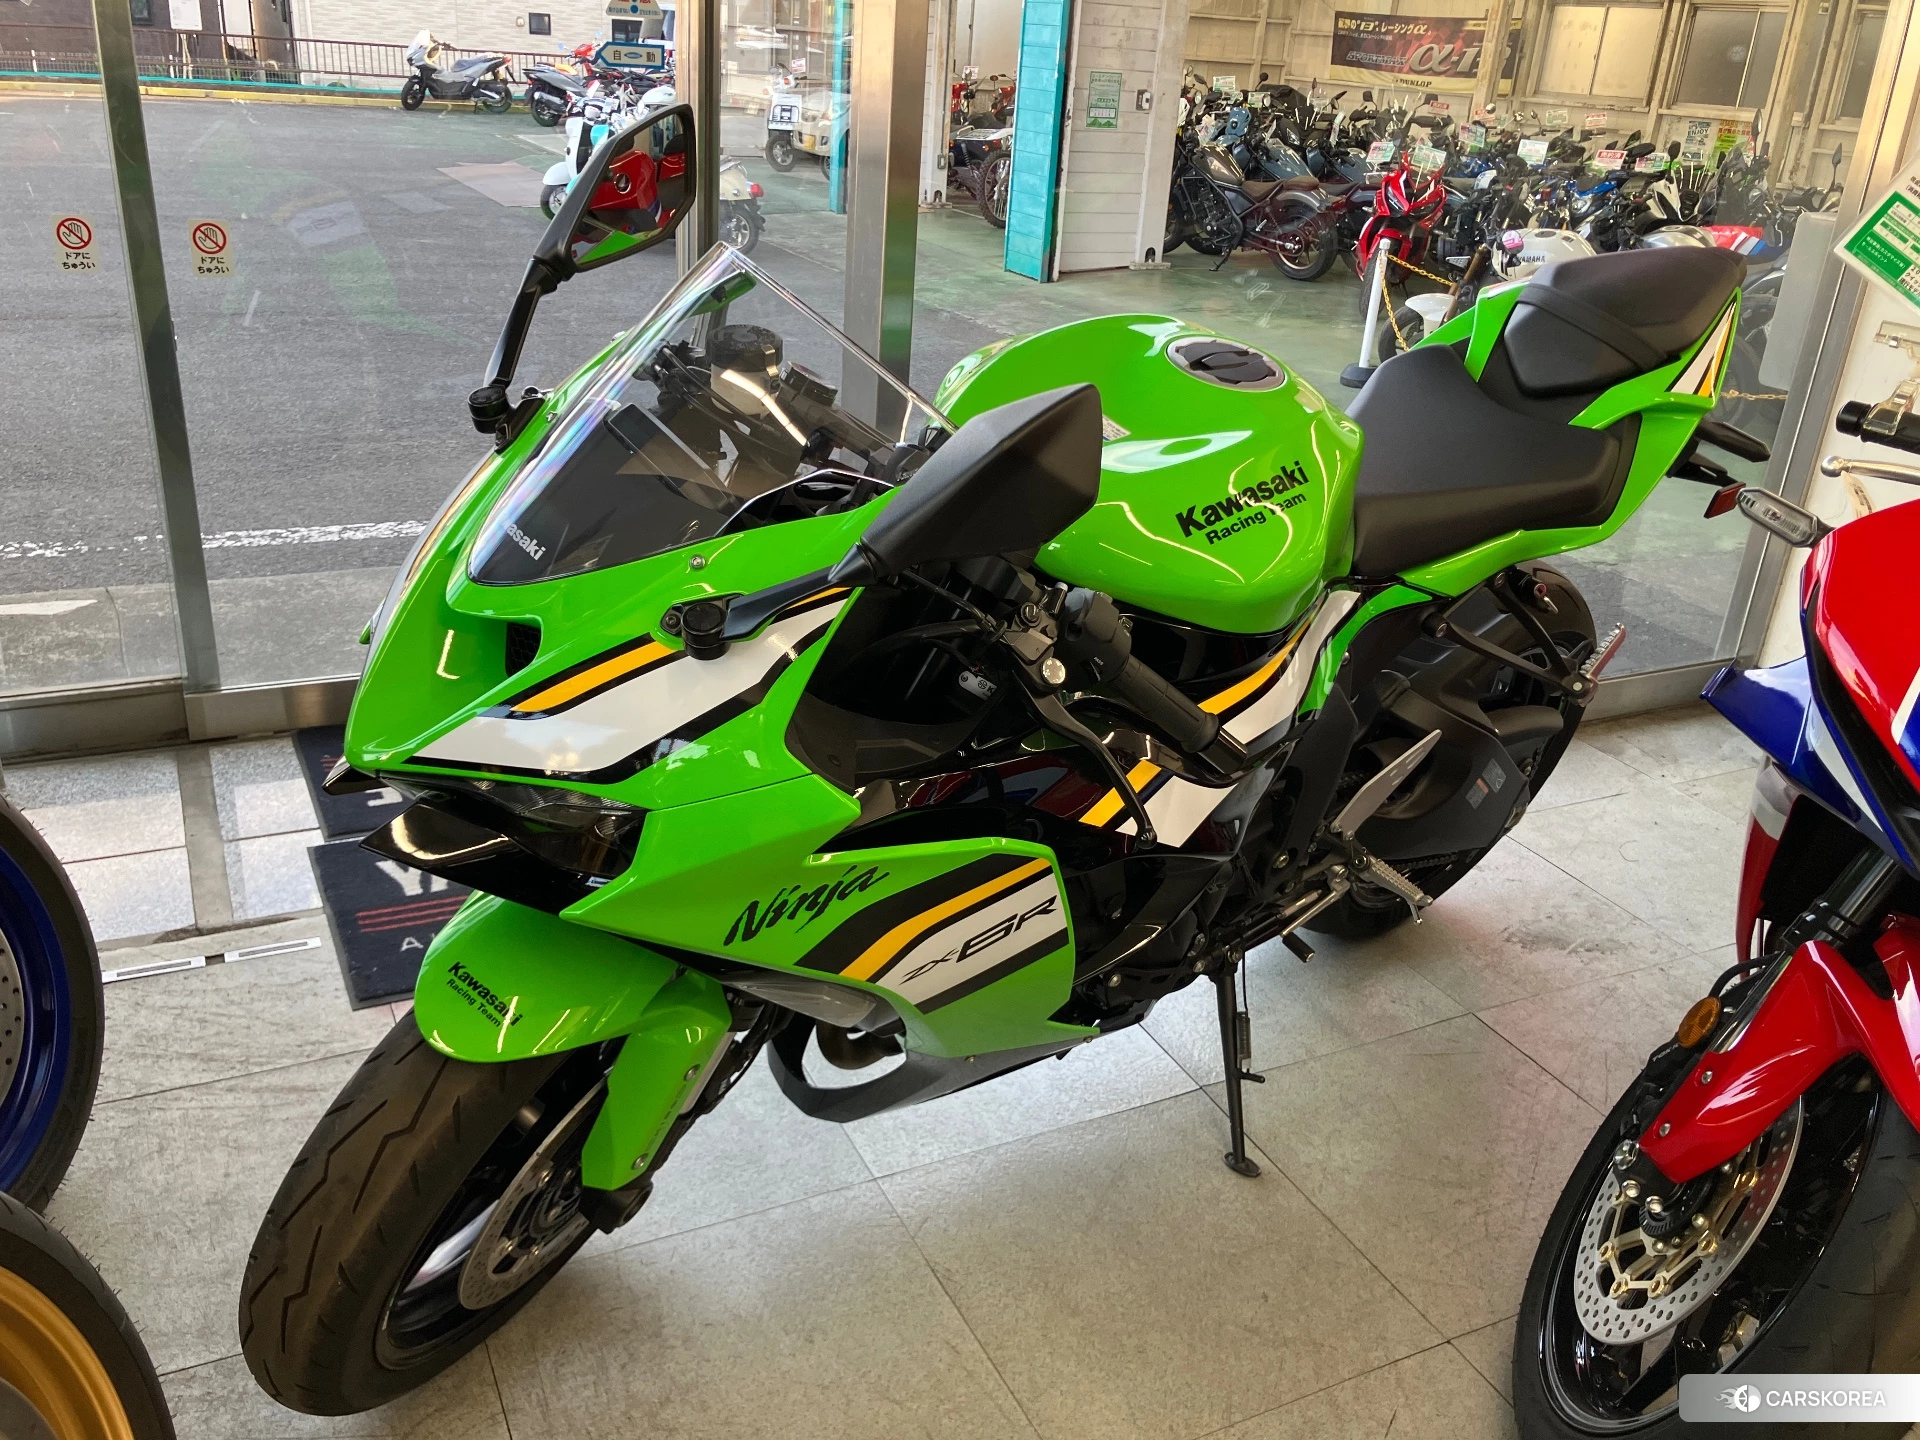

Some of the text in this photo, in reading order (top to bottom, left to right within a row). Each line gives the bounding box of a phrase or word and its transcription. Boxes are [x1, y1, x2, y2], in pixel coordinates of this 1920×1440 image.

[1399, 78, 1432, 88] DUNLOP
[1688, 128, 1709, 136] ENJOY
[62, 261, 95, 270] ちゅうい
[65, 252, 91, 260] ドアに
[197, 266, 229, 274] ちゅうい
[1175, 460, 1310, 538] Kawasaki
[1205, 510, 1267, 545] Racing
[723, 865, 890, 947] Ninja
[898, 894, 1058, 986] ZX-6R
[446, 978, 501, 1027] Racing Team
[448, 961, 523, 1026] Kawasai
